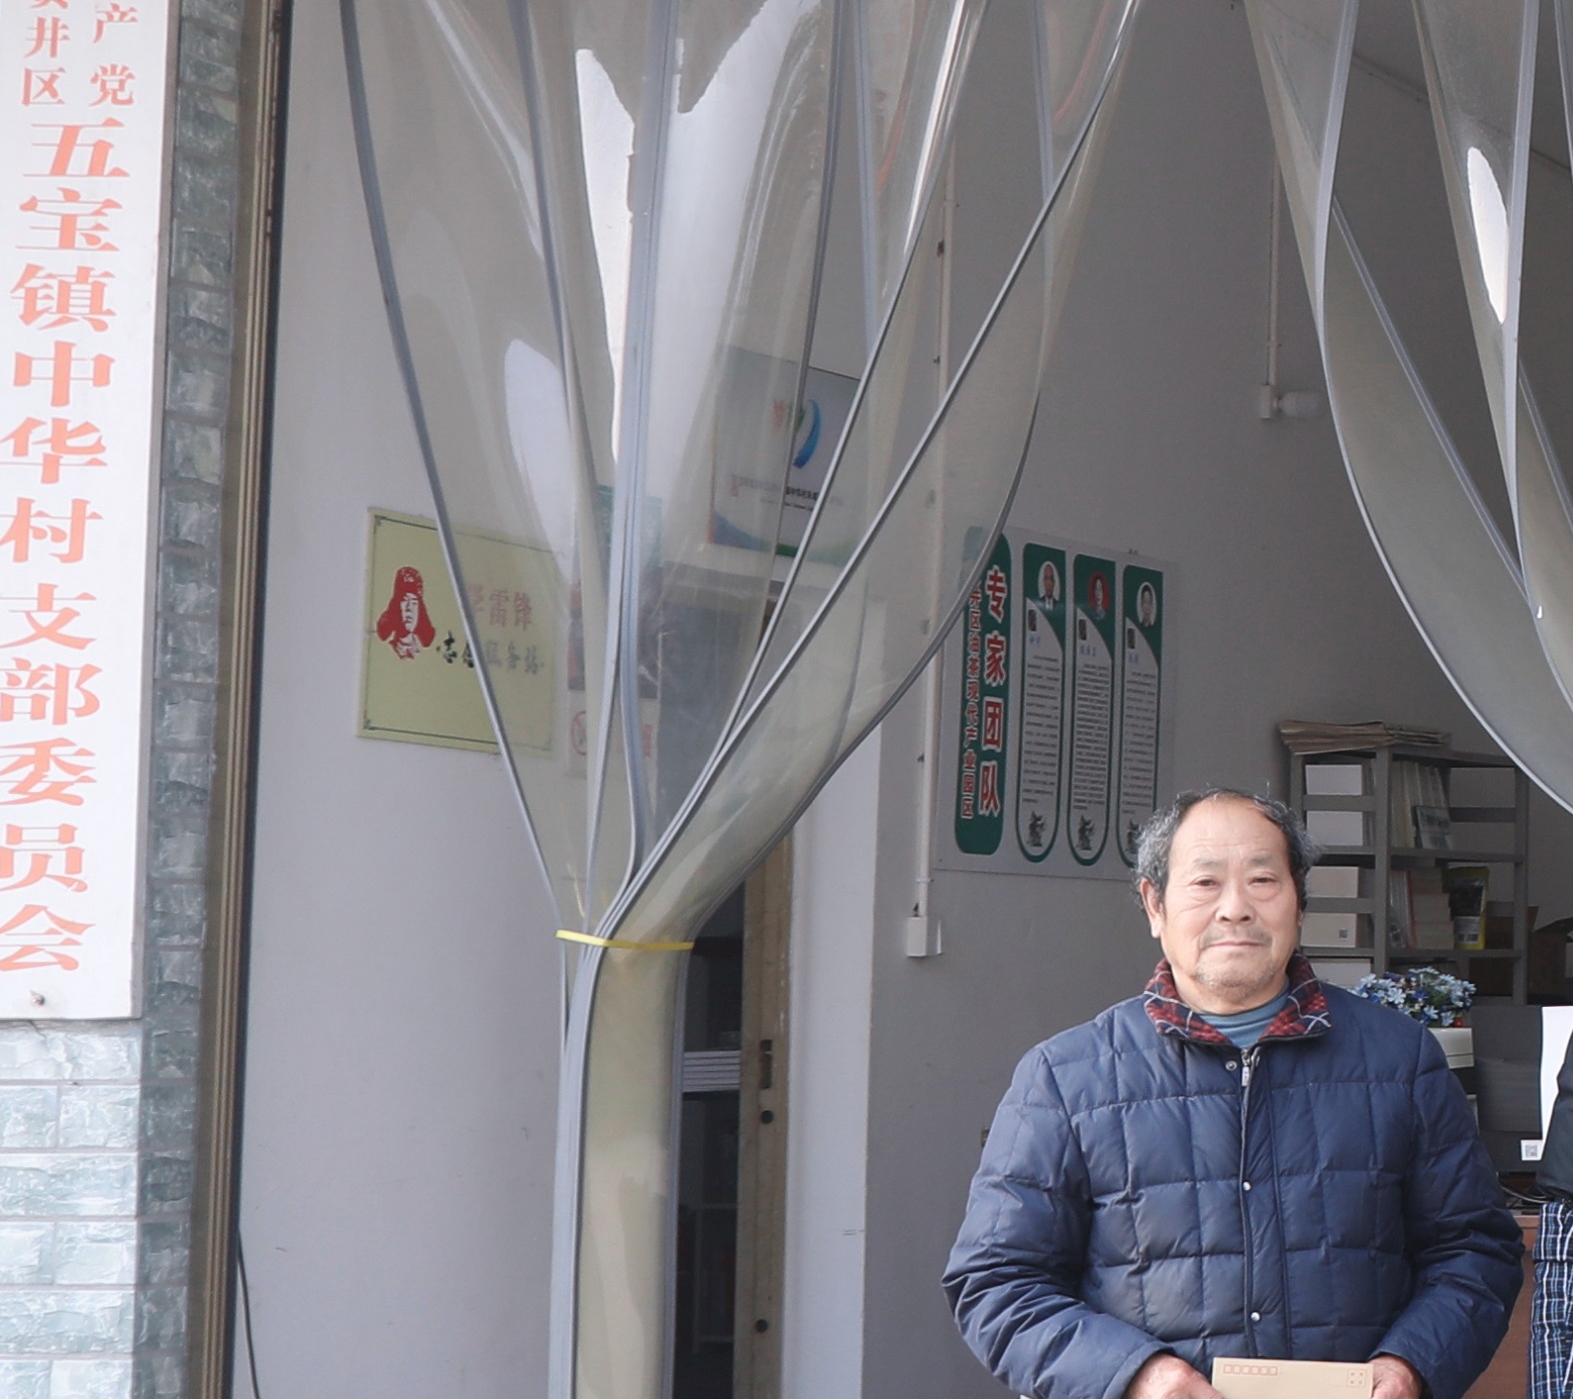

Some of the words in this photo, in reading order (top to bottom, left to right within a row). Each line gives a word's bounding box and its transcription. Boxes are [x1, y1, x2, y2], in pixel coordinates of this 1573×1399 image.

[0, 118, 129, 973] 五宝镇中华村支部委员会
[979, 564, 1008, 817] 专家团队
